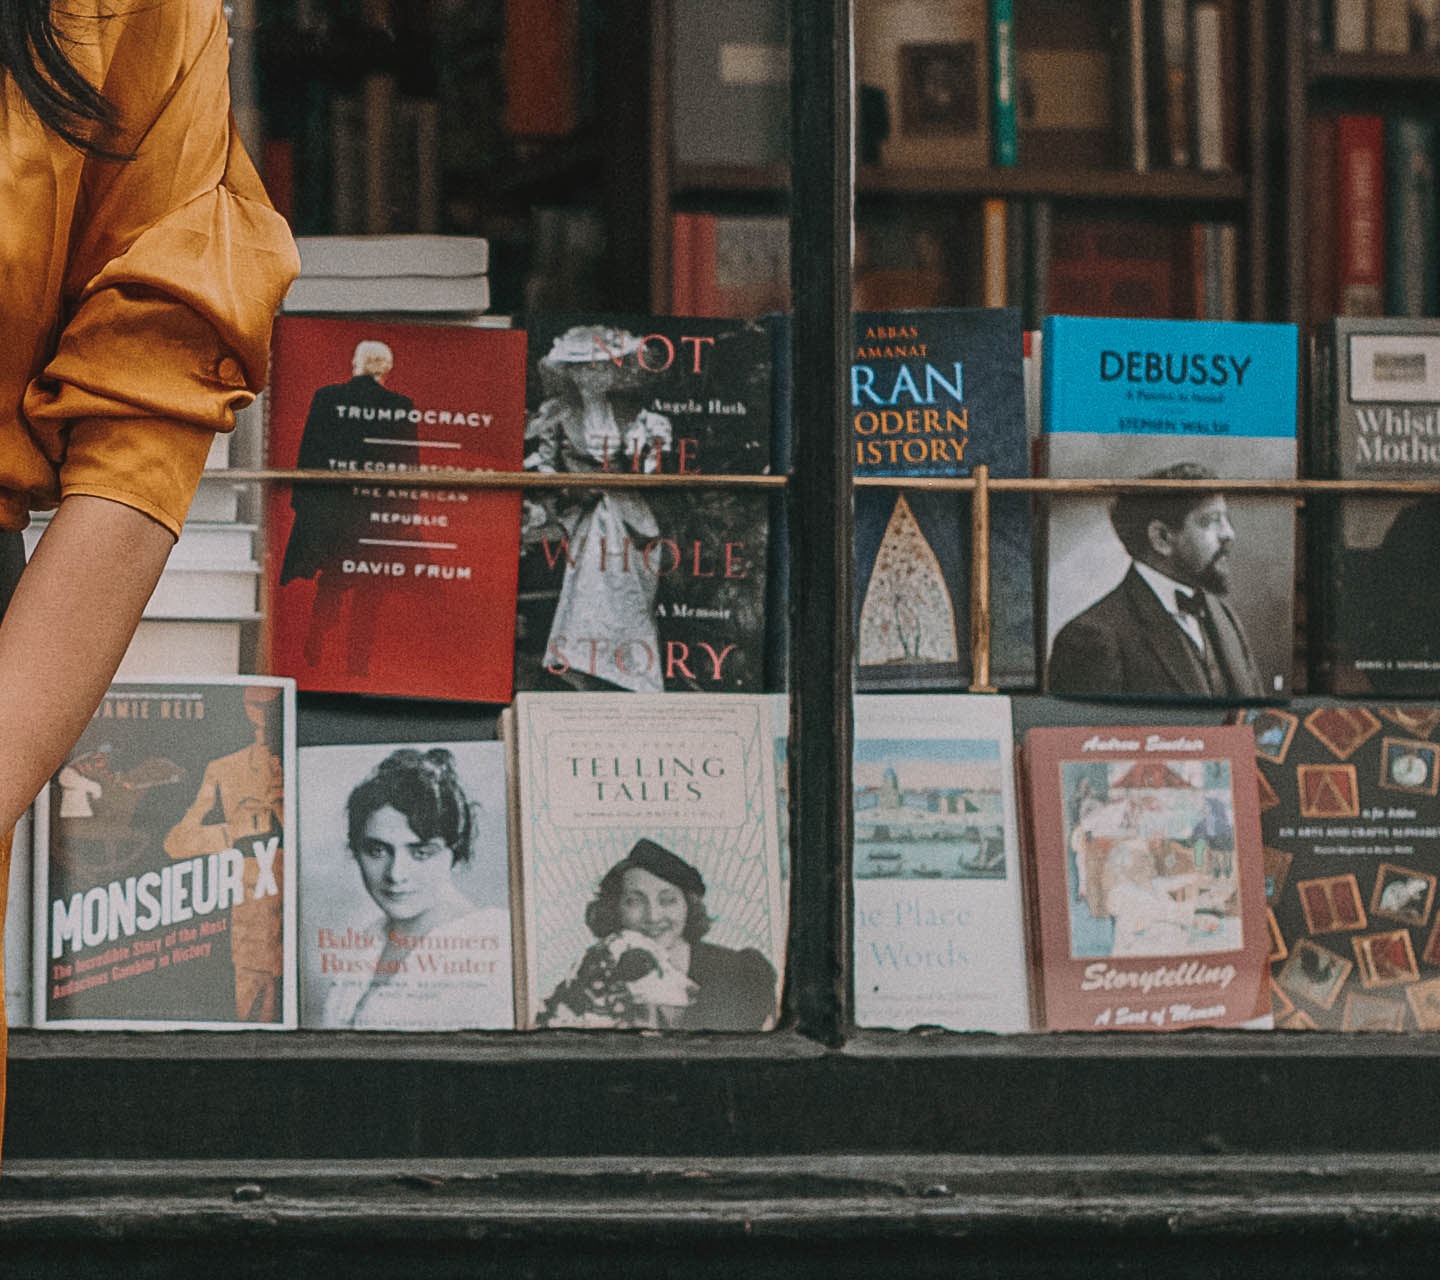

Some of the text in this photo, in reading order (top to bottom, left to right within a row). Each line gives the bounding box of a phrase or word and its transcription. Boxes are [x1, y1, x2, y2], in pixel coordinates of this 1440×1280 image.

[865, 325, 919, 340] ABBAS
[592, 334, 715, 374] NOT
[856, 344, 928, 359] AMANAT
[1099, 350, 1252, 386] DEBUSSY
[336, 404, 494, 428] TRUMPOCRACY
[590, 437, 702, 476] THE
[369, 511, 449, 528] REPUBLIC
[342, 560, 472, 580] DAVID FRUM
[542, 535, 746, 579] WHOLE
[546, 635, 736, 681] STORY
[566, 755, 726, 779] TELLING
[591, 780, 703, 803] TALES
[51, 836, 280, 960] MONSIEUR X
[1080, 959, 1238, 994] Storytelling
